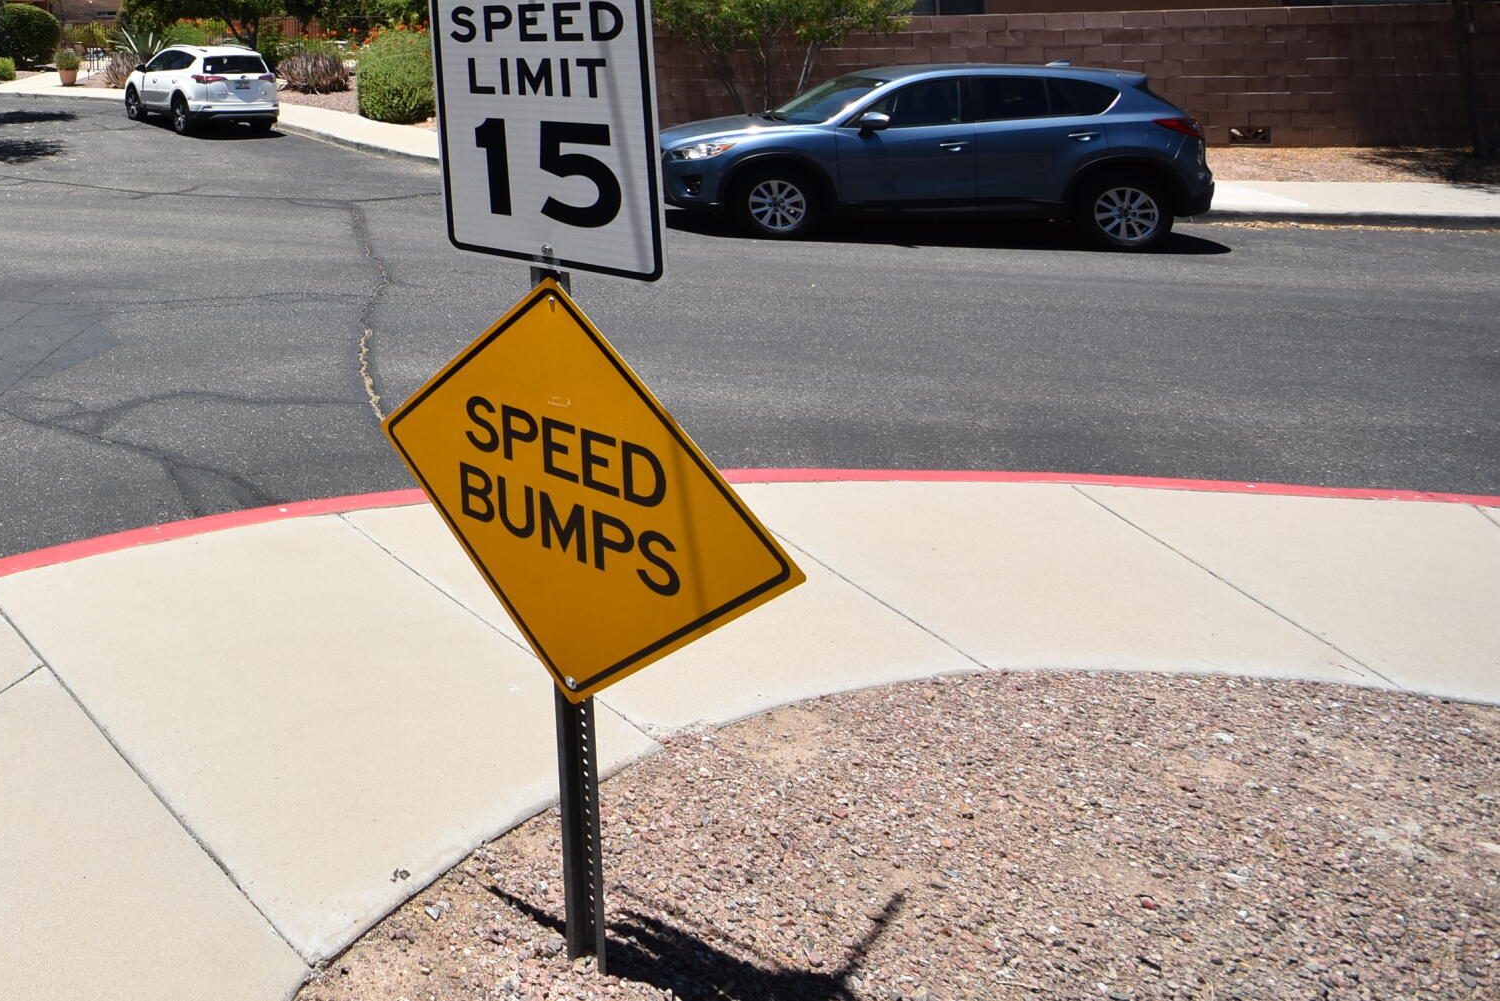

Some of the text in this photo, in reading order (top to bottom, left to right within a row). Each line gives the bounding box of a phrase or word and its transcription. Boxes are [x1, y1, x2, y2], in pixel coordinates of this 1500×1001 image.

[450, 1, 624, 43] SPEED
[467, 57, 607, 99] LIMIT
[474, 117, 622, 228] 15
[465, 395, 667, 508] SPEED
[459, 461, 681, 597] BUMPS
